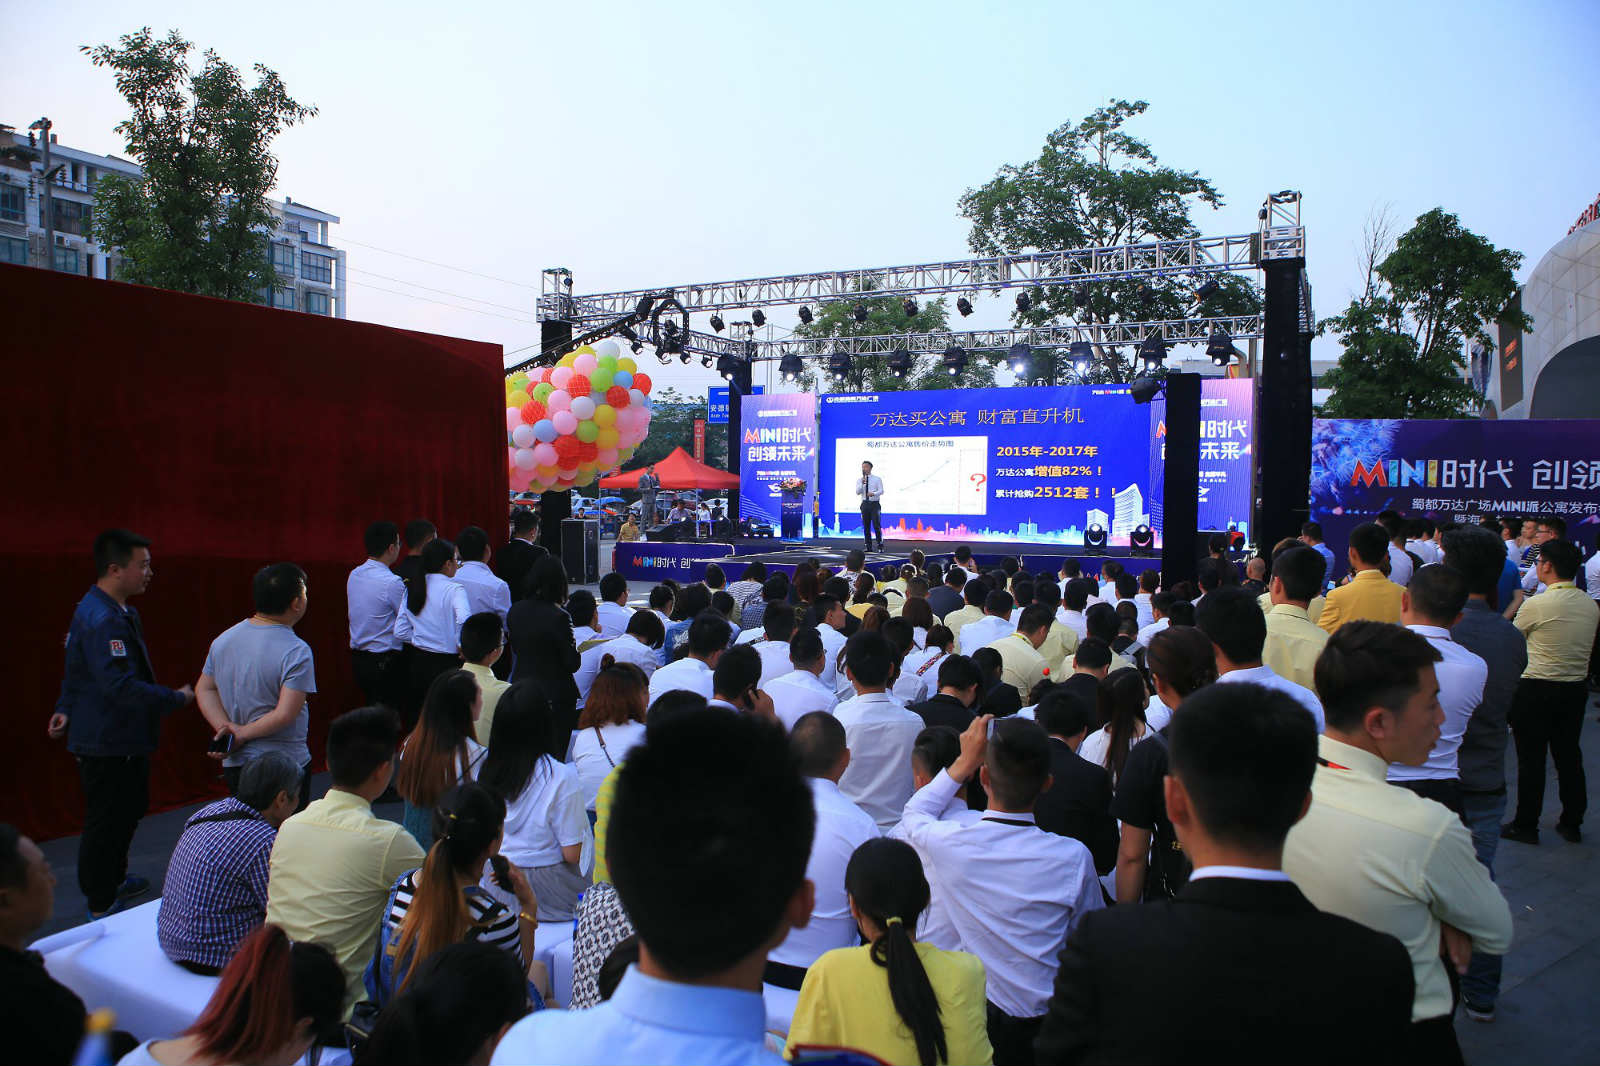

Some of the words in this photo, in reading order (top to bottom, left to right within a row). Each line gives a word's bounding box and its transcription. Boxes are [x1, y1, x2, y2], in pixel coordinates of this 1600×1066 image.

[870, 410, 967, 427] 万达买公寓
[977, 407, 1085, 425] 财富直升机
[744, 427, 812, 444] MINI时代
[996, 446, 1098, 457] 2015年-2017年
[1350, 458, 1513, 488] MINI时代
[1412, 498, 1600, 514] 蜀都万达广场MINI派公寓发布
